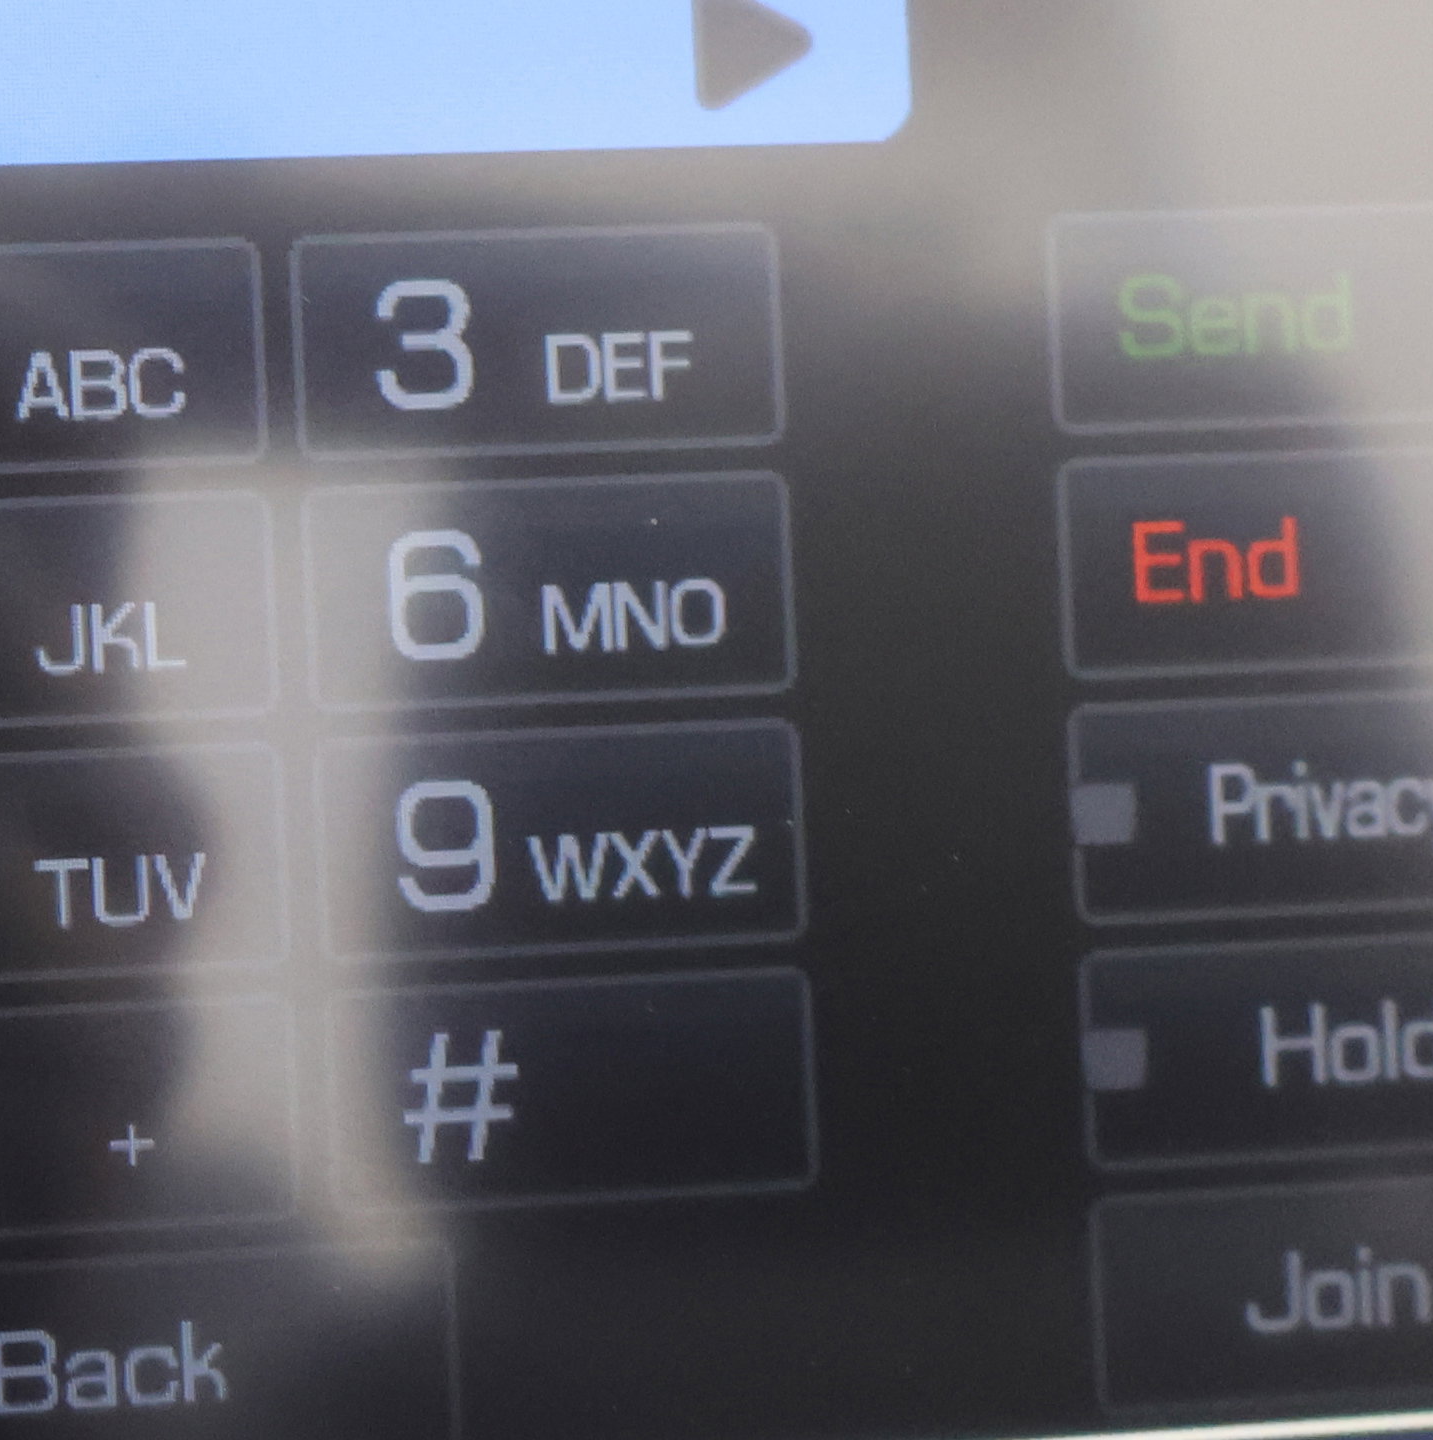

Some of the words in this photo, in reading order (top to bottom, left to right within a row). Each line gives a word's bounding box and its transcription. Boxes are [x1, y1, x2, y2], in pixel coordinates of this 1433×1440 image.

[375, 278, 471, 412] 3
[544, 330, 693, 404] DEF
[1117, 270, 1352, 359] Send
[17, 348, 188, 422] ABC
[387, 529, 484, 663] 6
[540, 578, 728, 656] MNO
[1132, 516, 1301, 602] End
[37, 601, 186, 676] JKL
[397, 779, 495, 913] 9
[529, 827, 758, 905] WXYZ
[34, 853, 207, 930] TUV
[405, 1031, 518, 1166] #
[1246, 1246, 1433, 1334] Join
